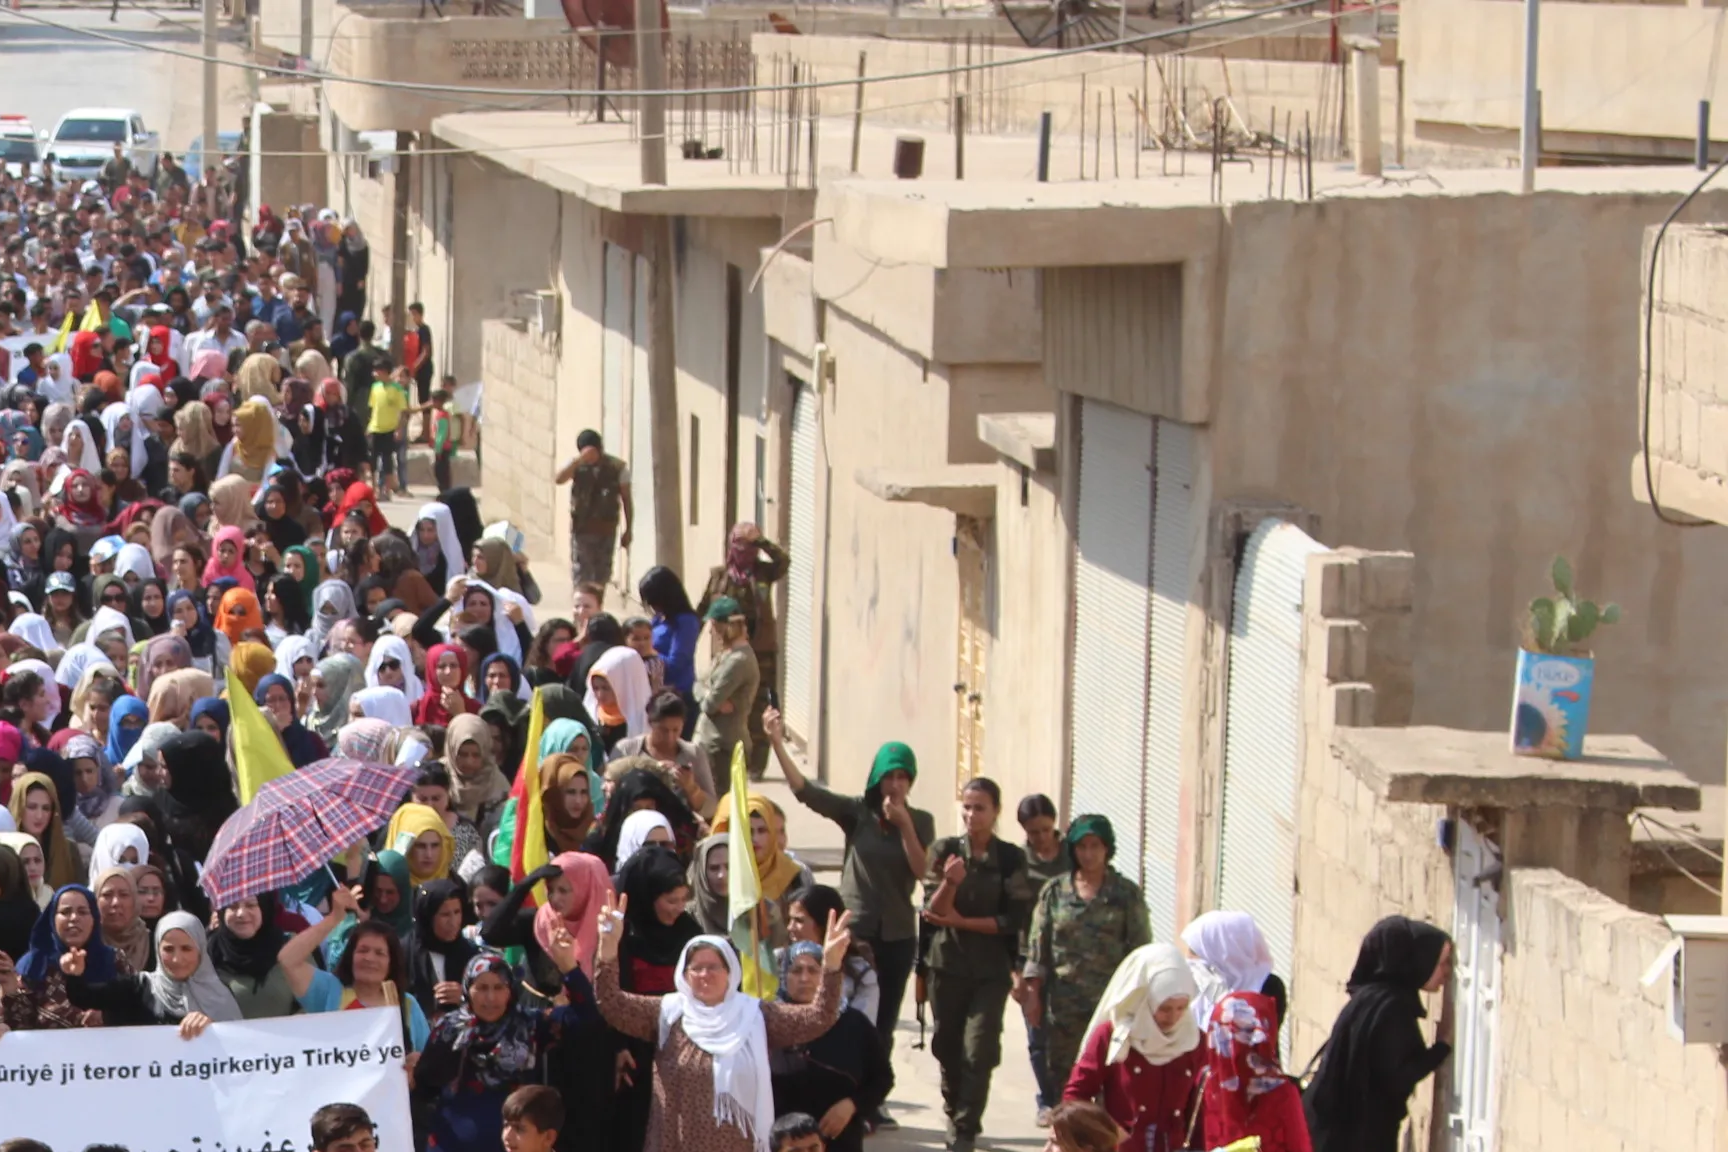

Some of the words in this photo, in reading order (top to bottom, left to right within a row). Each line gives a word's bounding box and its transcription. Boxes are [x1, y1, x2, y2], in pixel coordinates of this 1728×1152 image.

[60, 1063, 75, 1085] ji
[83, 1063, 141, 1080] teror
[148, 1060, 162, 1078] û
[170, 1053, 295, 1080] dagirkeriya
[303, 1044, 371, 1067] Tirkyê
[378, 1044, 403, 1063] ye
